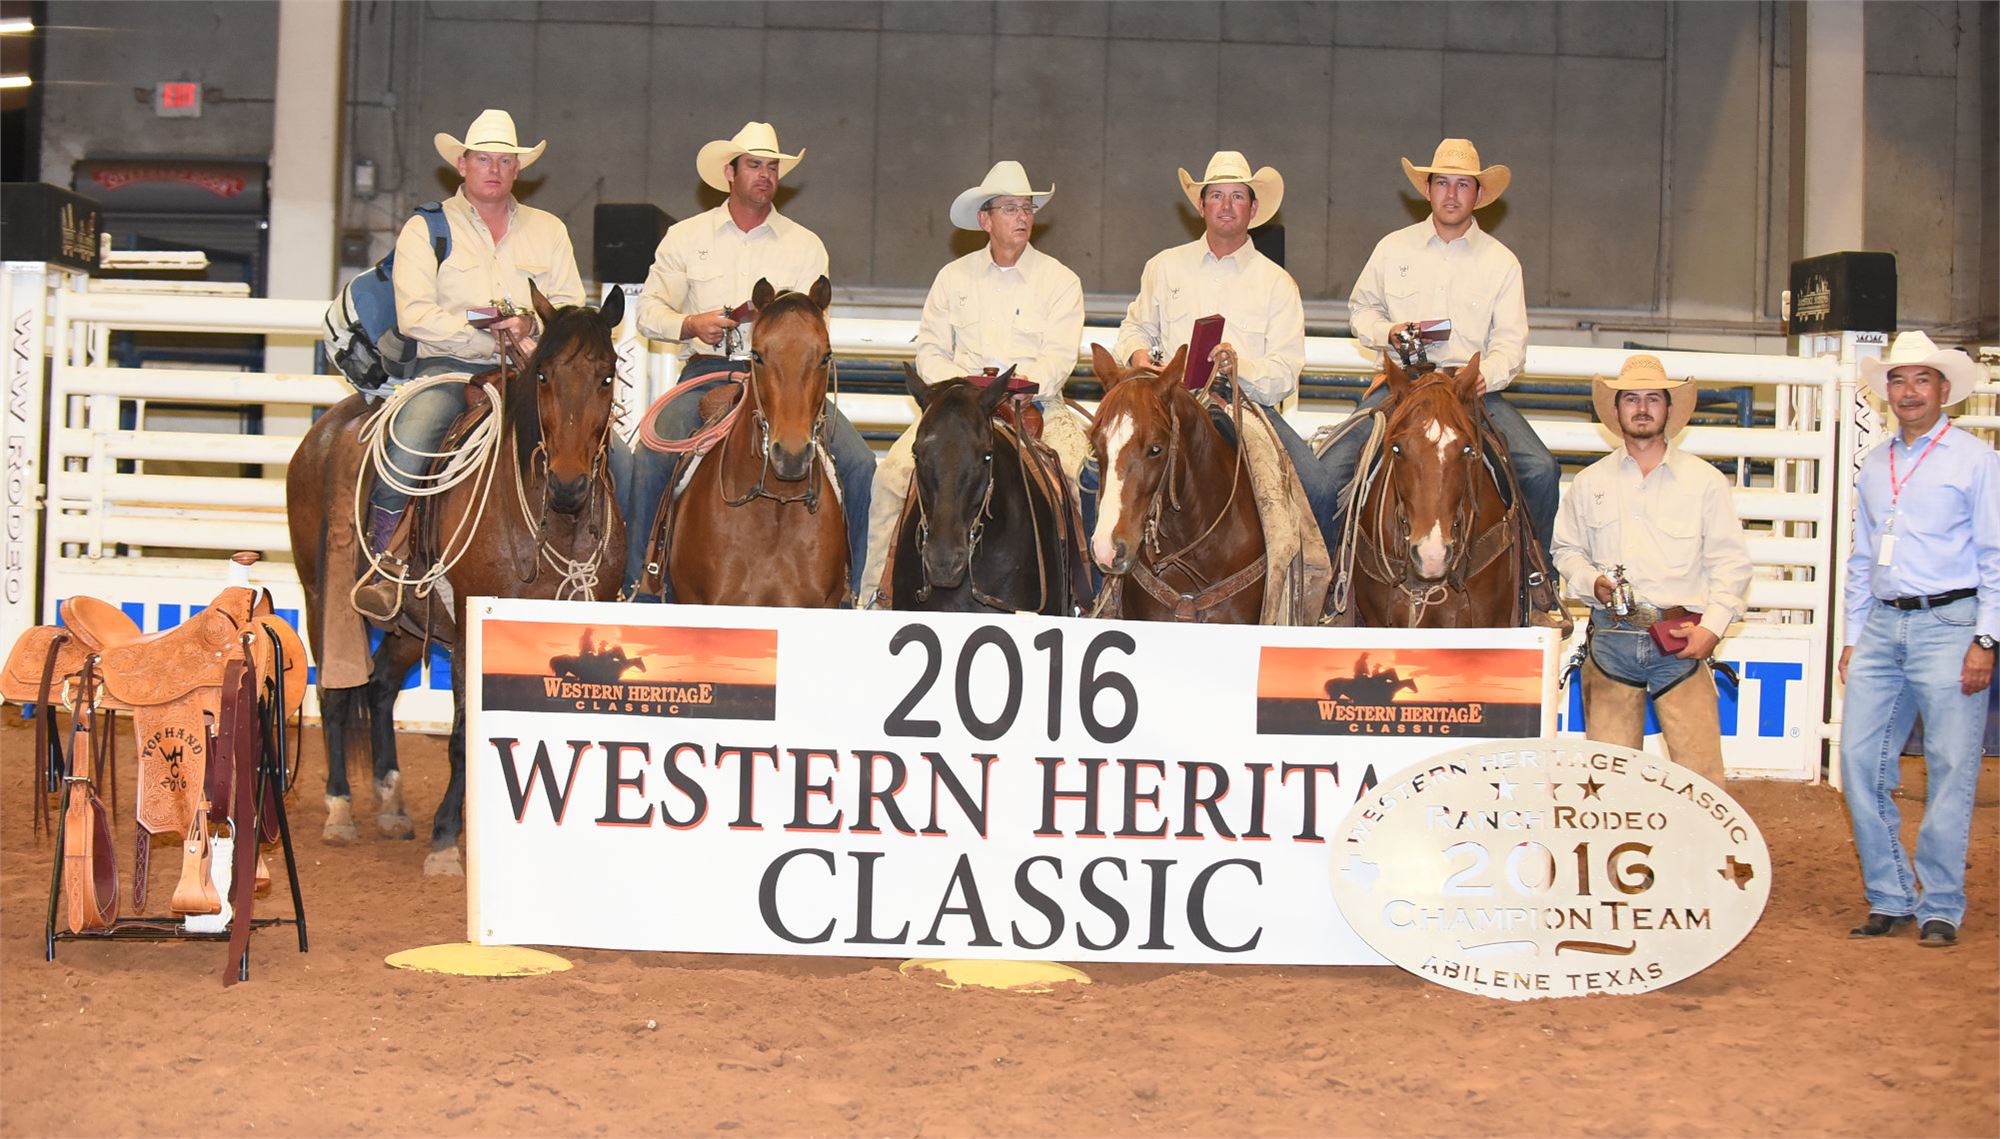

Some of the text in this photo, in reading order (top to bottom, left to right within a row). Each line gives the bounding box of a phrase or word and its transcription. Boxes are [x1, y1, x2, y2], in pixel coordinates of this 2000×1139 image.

[6, 435, 26, 604] RODEO
[543, 676, 713, 705] WESTERN HERITAGE
[883, 623, 1138, 743] 2016
[575, 701, 679, 714] CLASSIC
[1317, 700, 1483, 724] WESTERN HERITAGE
[142, 727, 203, 758] TOP HAND
[1349, 723, 1451, 734] CLASSIC
[160, 777, 187, 792] 2016
[488, 736, 1000, 839] WESTERN
[1347, 749, 1749, 845] WESTERN HERITAGE CLASSIC
[1553, 805, 1667, 830] RODEO
[1441, 841, 1655, 896] 2016
[758, 847, 1263, 953] CLASSIC
[1383, 899, 1711, 930] CHAMPION TEAM
[1420, 956, 1663, 991] ABILENE TEXAS
